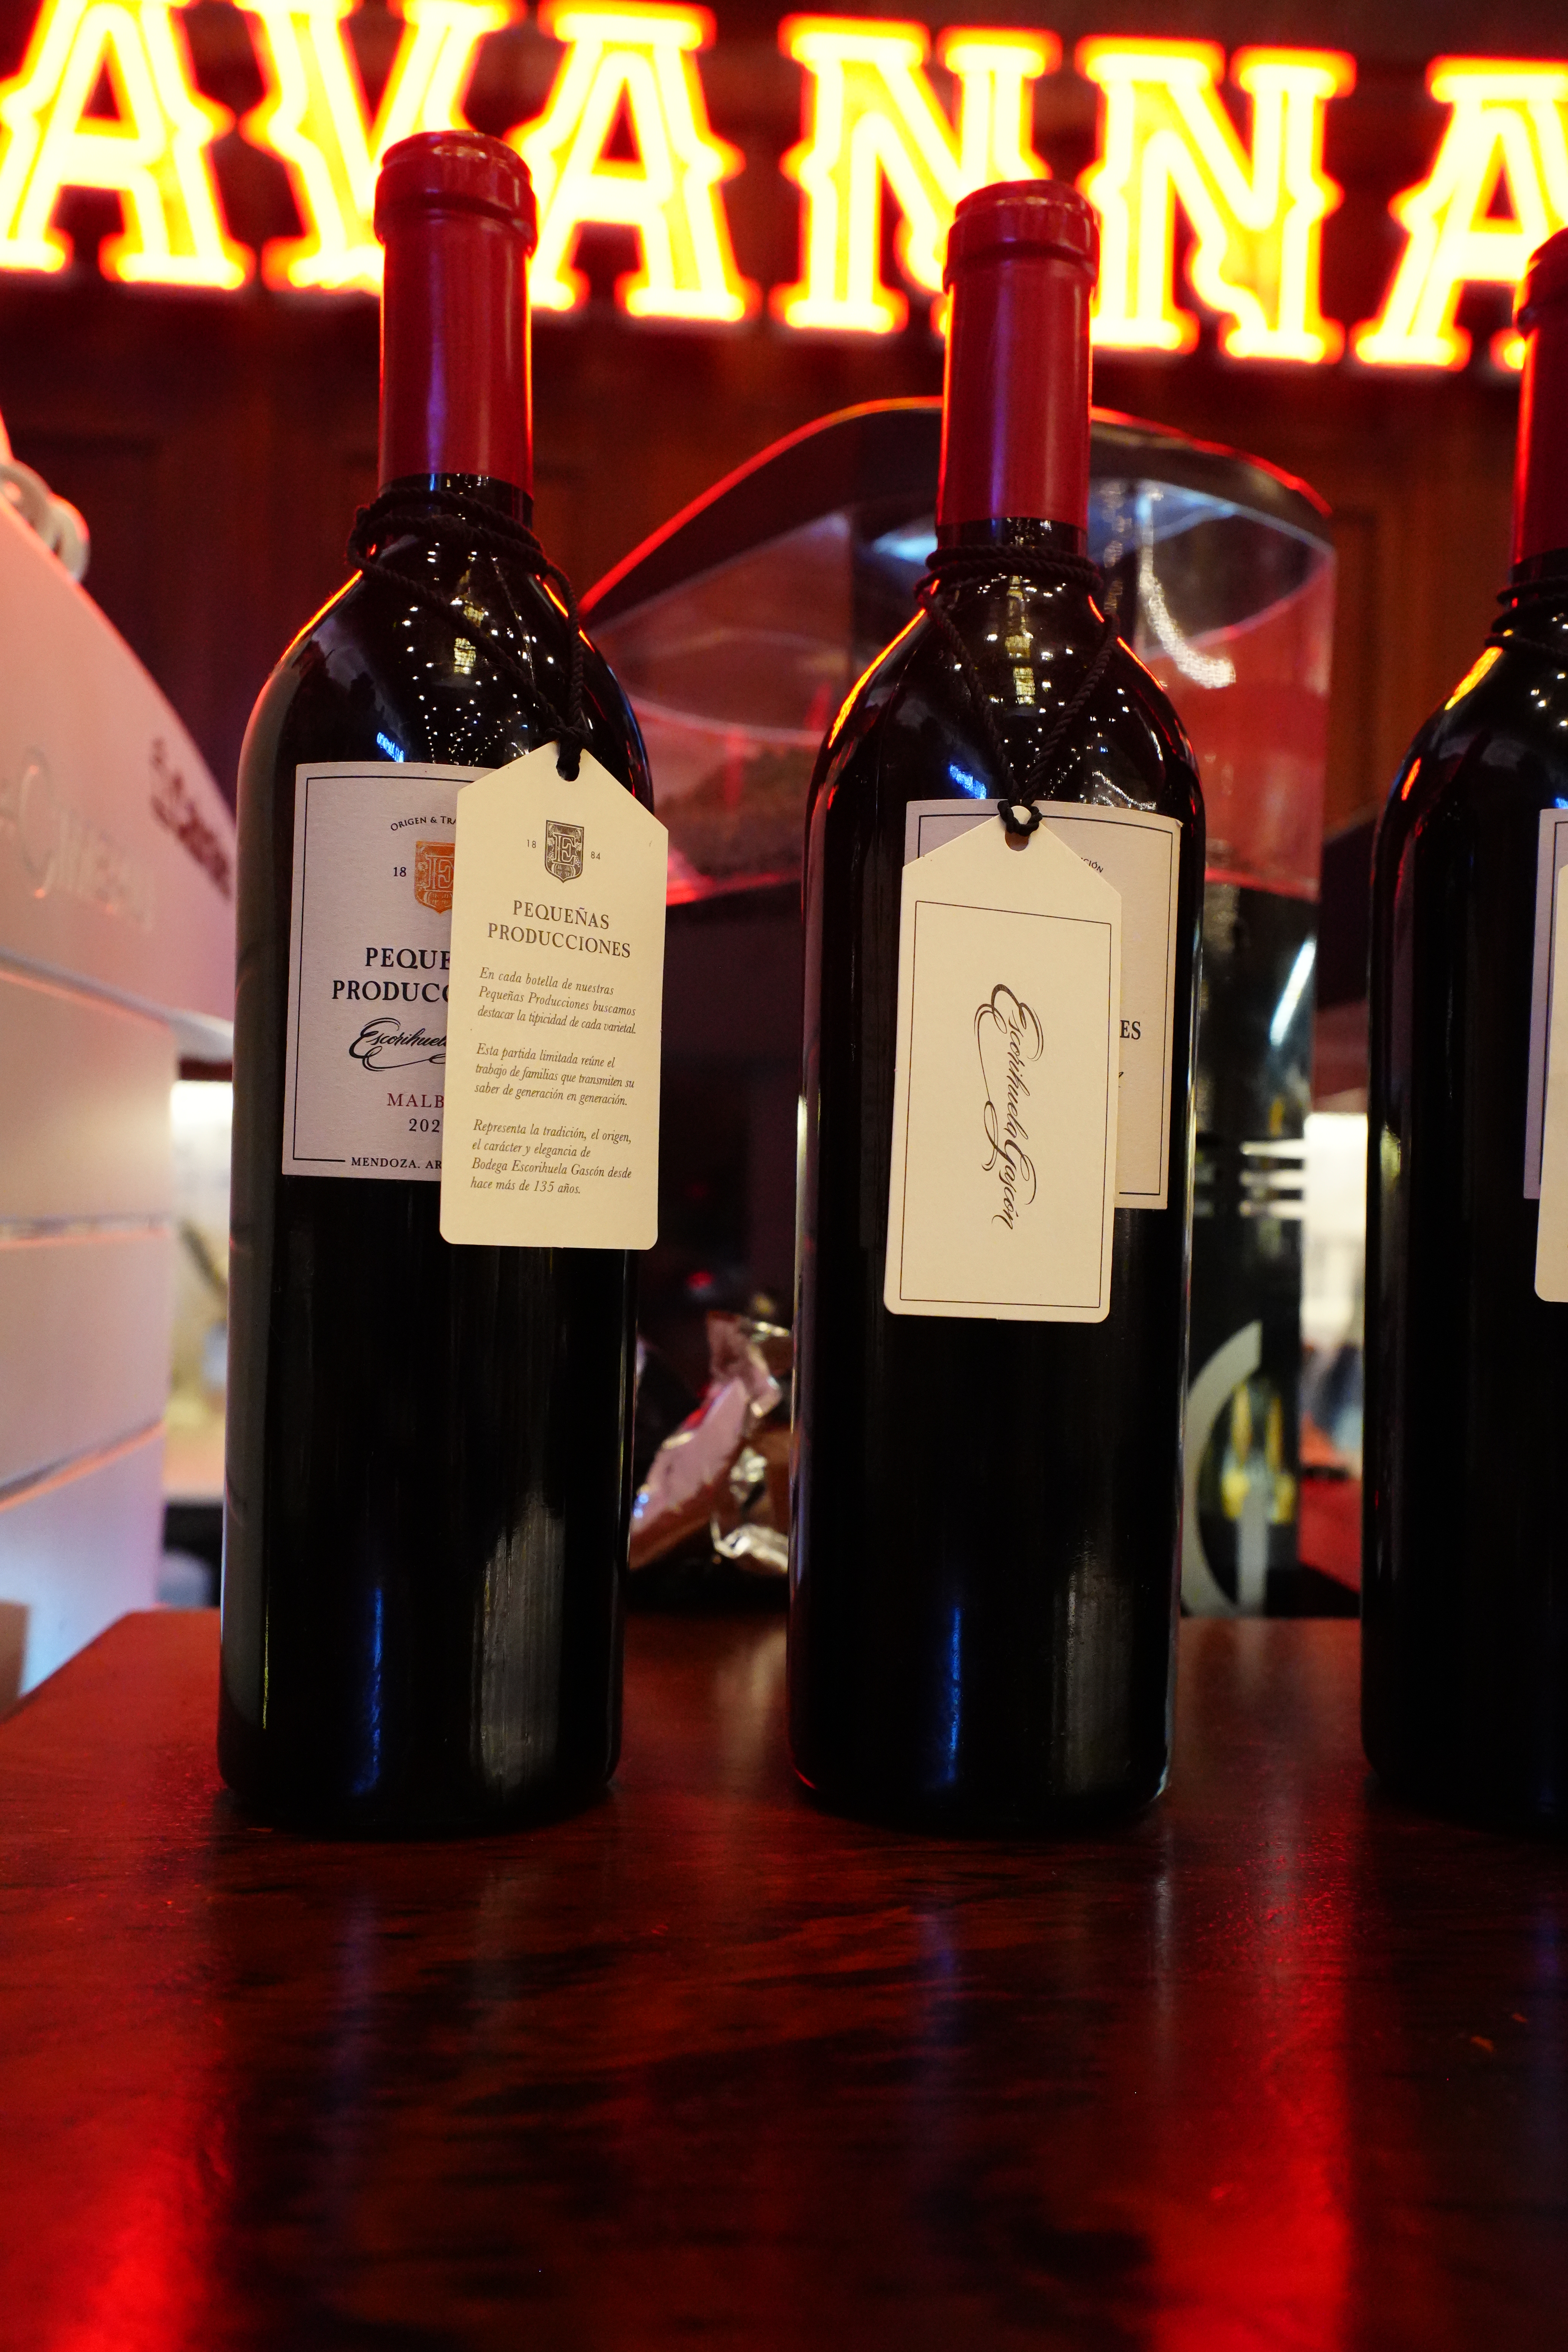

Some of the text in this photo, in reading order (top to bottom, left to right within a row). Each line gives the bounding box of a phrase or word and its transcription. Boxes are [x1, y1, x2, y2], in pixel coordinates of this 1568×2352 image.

[391, 817, 427, 831] ORIGEN
[526, 839, 536, 848] 18
[591, 851, 601, 860] 84
[393, 867, 407, 877] 18
[513, 899, 610, 930] PEQUEÑAS
[487, 922, 631, 958] PRODUCCIONES
[480, 967, 614, 995] En cada botella de nuestras
[478, 985, 636, 1016] Pequeñas Producciones buscamos
[477, 1005, 636, 1034] destacar la tipicidad de cada varietal.
[476, 1043, 615, 1068] Esta partida limitada reúne el
[974, 984, 1043, 1139] Escorihuela
[475, 1063, 634, 1088] trabajo de familias que transmiten su
[474, 1083, 628, 1106] saber de generación en generación.
[473, 1119, 631, 1144] Representa la tradición, el origen,
[472, 1140, 591, 1158] el carácter y elegancia de
[351, 1157, 420, 1168] MENDOZA.
[471, 1157, 632, 1178] Bodega Escorihuela Gascón desde
[470, 1177, 580, 1194] hace más de 135 años.
